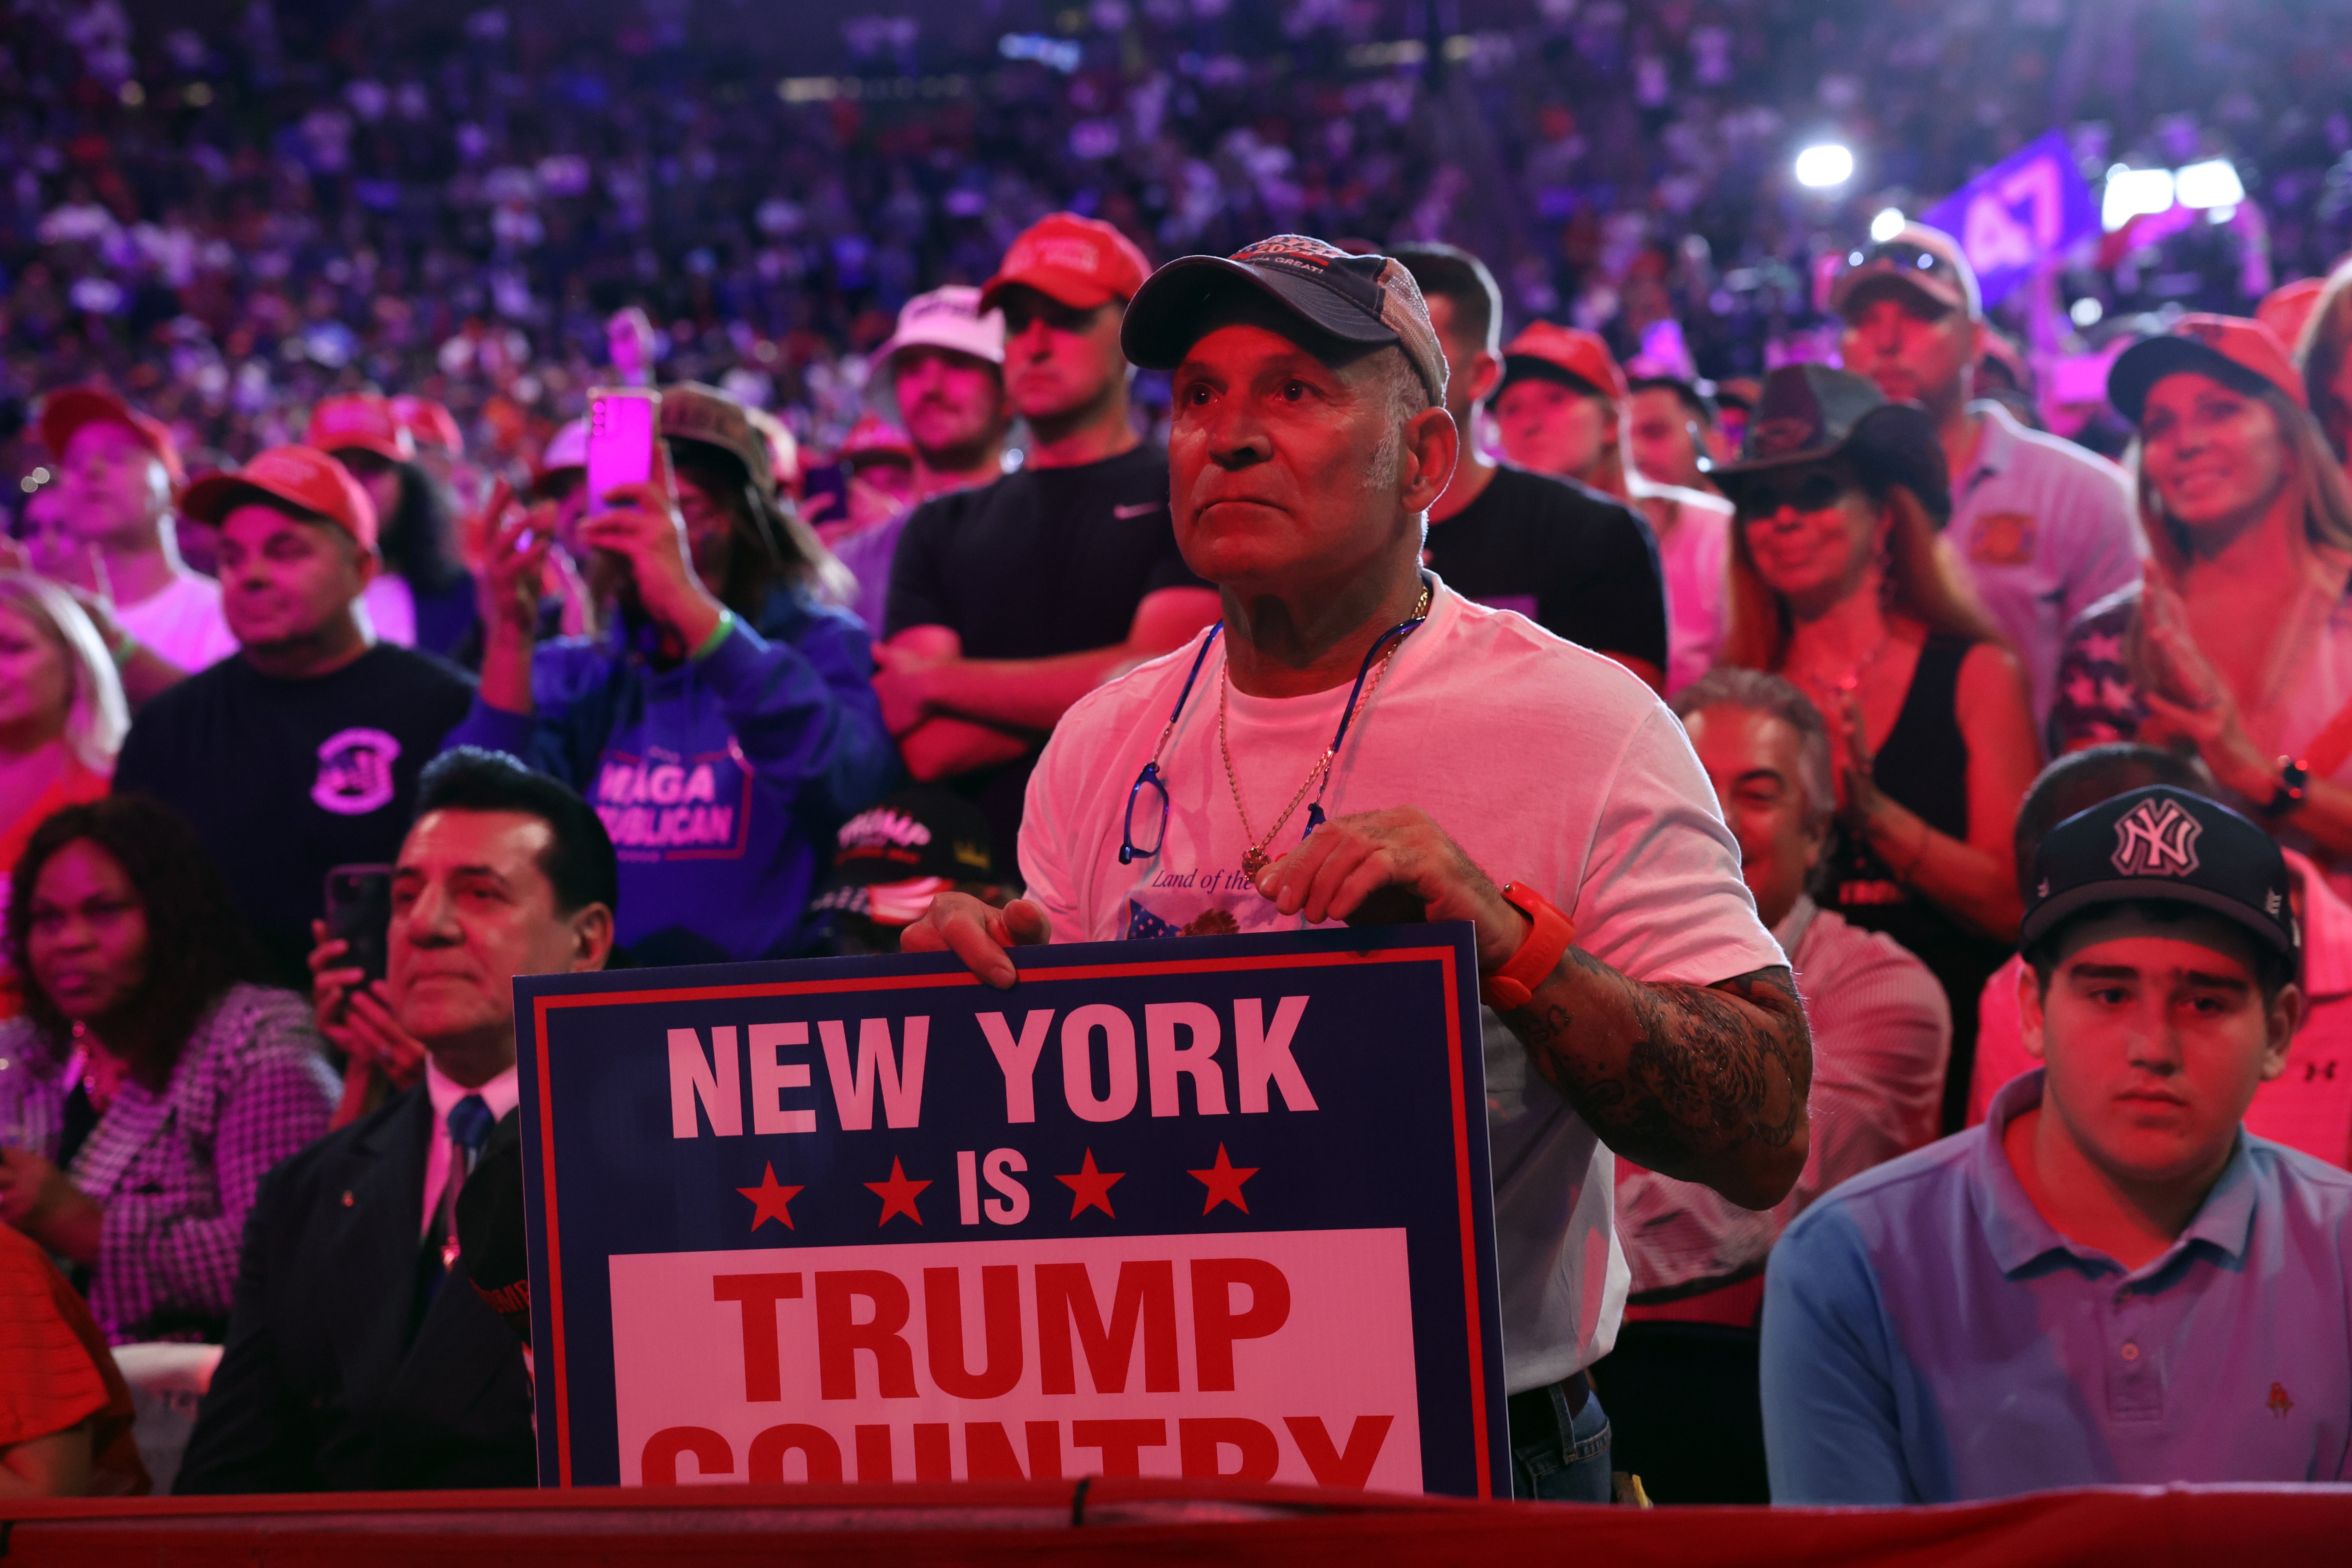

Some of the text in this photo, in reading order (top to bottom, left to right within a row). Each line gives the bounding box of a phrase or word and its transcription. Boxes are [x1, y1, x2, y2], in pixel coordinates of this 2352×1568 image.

[1274, 257, 1324, 274] GREAT!
[2118, 804, 2195, 869] NY
[1152, 868, 1252, 894] Land of the
[668, 996, 1319, 1138] NEW YORK
[957, 1148, 1029, 1225] IS
[713, 1258, 1290, 1402] TRUMP
